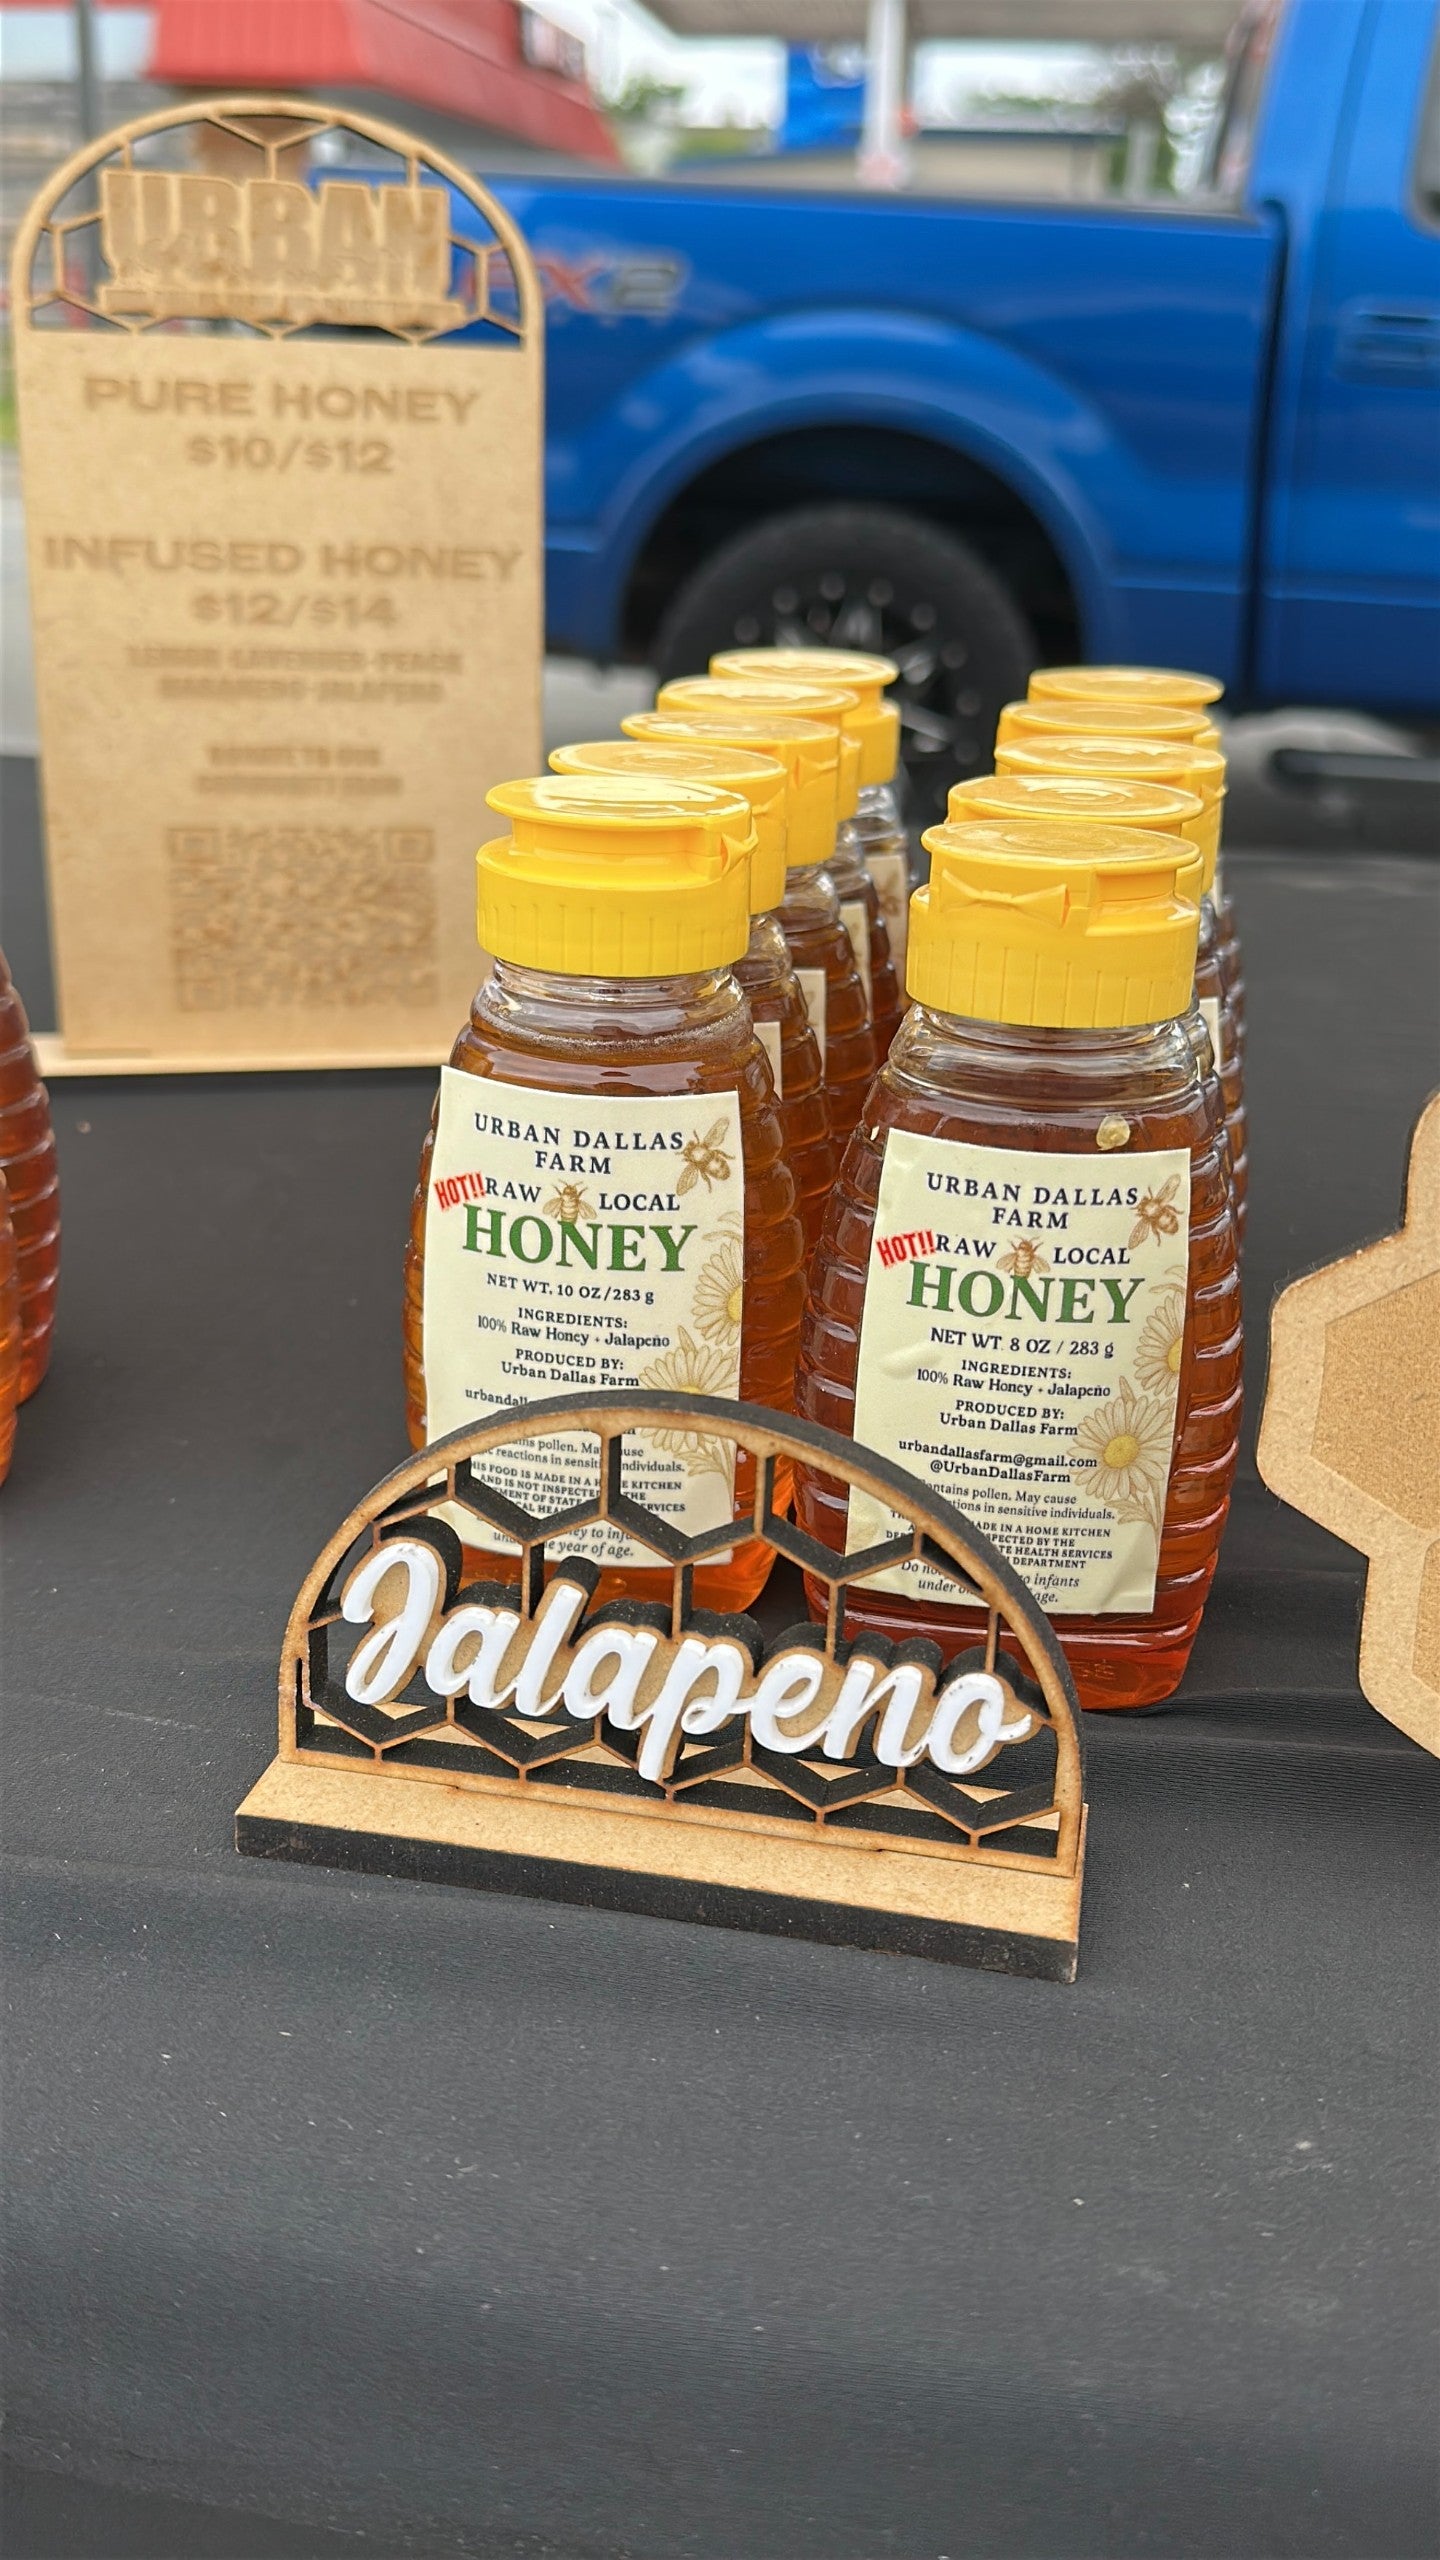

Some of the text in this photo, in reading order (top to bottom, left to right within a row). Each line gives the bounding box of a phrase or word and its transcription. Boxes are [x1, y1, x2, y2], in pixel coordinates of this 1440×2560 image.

[103, 170, 448, 298] URBAN
[83, 377, 481, 424] PURE HONEY
[186, 435, 394, 475] $10/$12
[43, 535, 523, 581] INFUSED HONEY
[191, 590, 398, 627] $12/$14
[474, 1112, 683, 1150] URBAN DALLAS
[535, 1150, 611, 1175] FARM
[433, 1171, 486, 1212] HOT!!
[485, 1177, 681, 1211] RAW LOCAL
[927, 1172, 1138, 1205] URBAN DALLAS
[992, 1206, 1069, 1229] FARM
[462, 1203, 698, 1272] HONEY
[876, 1229, 936, 1268] HOT!!
[936, 1234, 1130, 1265] RAW LOCAL
[487, 1273, 518, 1289] NET
[557, 1284, 574, 1297] 10
[645, 1290, 654, 1305] g
[906, 1260, 1145, 1323] HONEY
[477, 1315, 507, 1333] 100%
[511, 1321, 541, 1339] Raw
[545, 1327, 589, 1346] Honey
[518, 1307, 628, 1329] INGREDIENTS:
[931, 1327, 967, 1346] NET
[1009, 1337, 1020, 1352] 8
[1026, 1339, 1051, 1354] OZ
[1056, 1341, 1064, 1355] /
[1069, 1340, 1098, 1355] 283
[1104, 1342, 1114, 1359] g
[516, 1349, 624, 1370] PRODUCED BY:
[961, 1359, 1072, 1379] INGREDIENTS:
[501, 1361, 639, 1387] Urban Dallas Farm
[917, 1368, 948, 1385] 100%
[953, 1374, 983, 1391] Raw
[988, 1378, 1033, 1397] Honey
[955, 1399, 1065, 1420] PRODUCED BY:
[940, 1412, 1078, 1436] Urban Dallas Farm
[496, 1448, 548, 1463] reactions
[551, 1453, 561, 1465] in
[565, 1457, 599, 1468] sensit
[622, 1460, 685, 1473] ndividuals.
[538, 1439, 578, 1453] pollen.
[581, 1442, 601, 1454] Ma
[620, 1446, 644, 1457] use
[899, 1439, 1098, 1469] urbandallasfarm@gmail.com
[471, 1460, 486, 1471] HIS
[489, 1465, 517, 1477] FOOD
[522, 1469, 531, 1479] IS
[534, 1472, 566, 1484] MADE
[569, 1476, 581, 1485] IN
[584, 1478, 591, 1487] A
[632, 1481, 682, 1490] KITCHEN
[480, 1474, 502, 1485] AND
[505, 1478, 514, 1487] IS
[517, 1481, 540, 1491] NOT
[930, 1459, 1071, 1484] @UrbanDallasFarm
[532, 1494, 545, 1503] OF
[643, 1503, 686, 1512] RVICES
[924, 1481, 1077, 1505] ontains pollen. May cause
[951, 1499, 1116, 1521] tions in sensitive individuals.
[591, 1527, 603, 1538] to
[971, 1520, 1111, 1538] ADE IN A HOME KITCHEN
[986, 1533, 1075, 1547] SPECTED BY THE
[558, 1541, 587, 1554] year
[592, 1542, 605, 1557] of
[608, 1545, 634, 1558] age.
[1015, 1546, 1059, 1557] HEALTH
[1062, 1548, 1113, 1559] SERVICES
[901, 1560, 919, 1572] Do
[922, 1564, 941, 1576] no
[1034, 1573, 1079, 1588] infants
[1013, 1557, 1086, 1569] DEPARTMENT
[918, 1579, 956, 1593] under
[1034, 1590, 1058, 1604] age.
[340, 1541, 1032, 1781] Jalapeno
